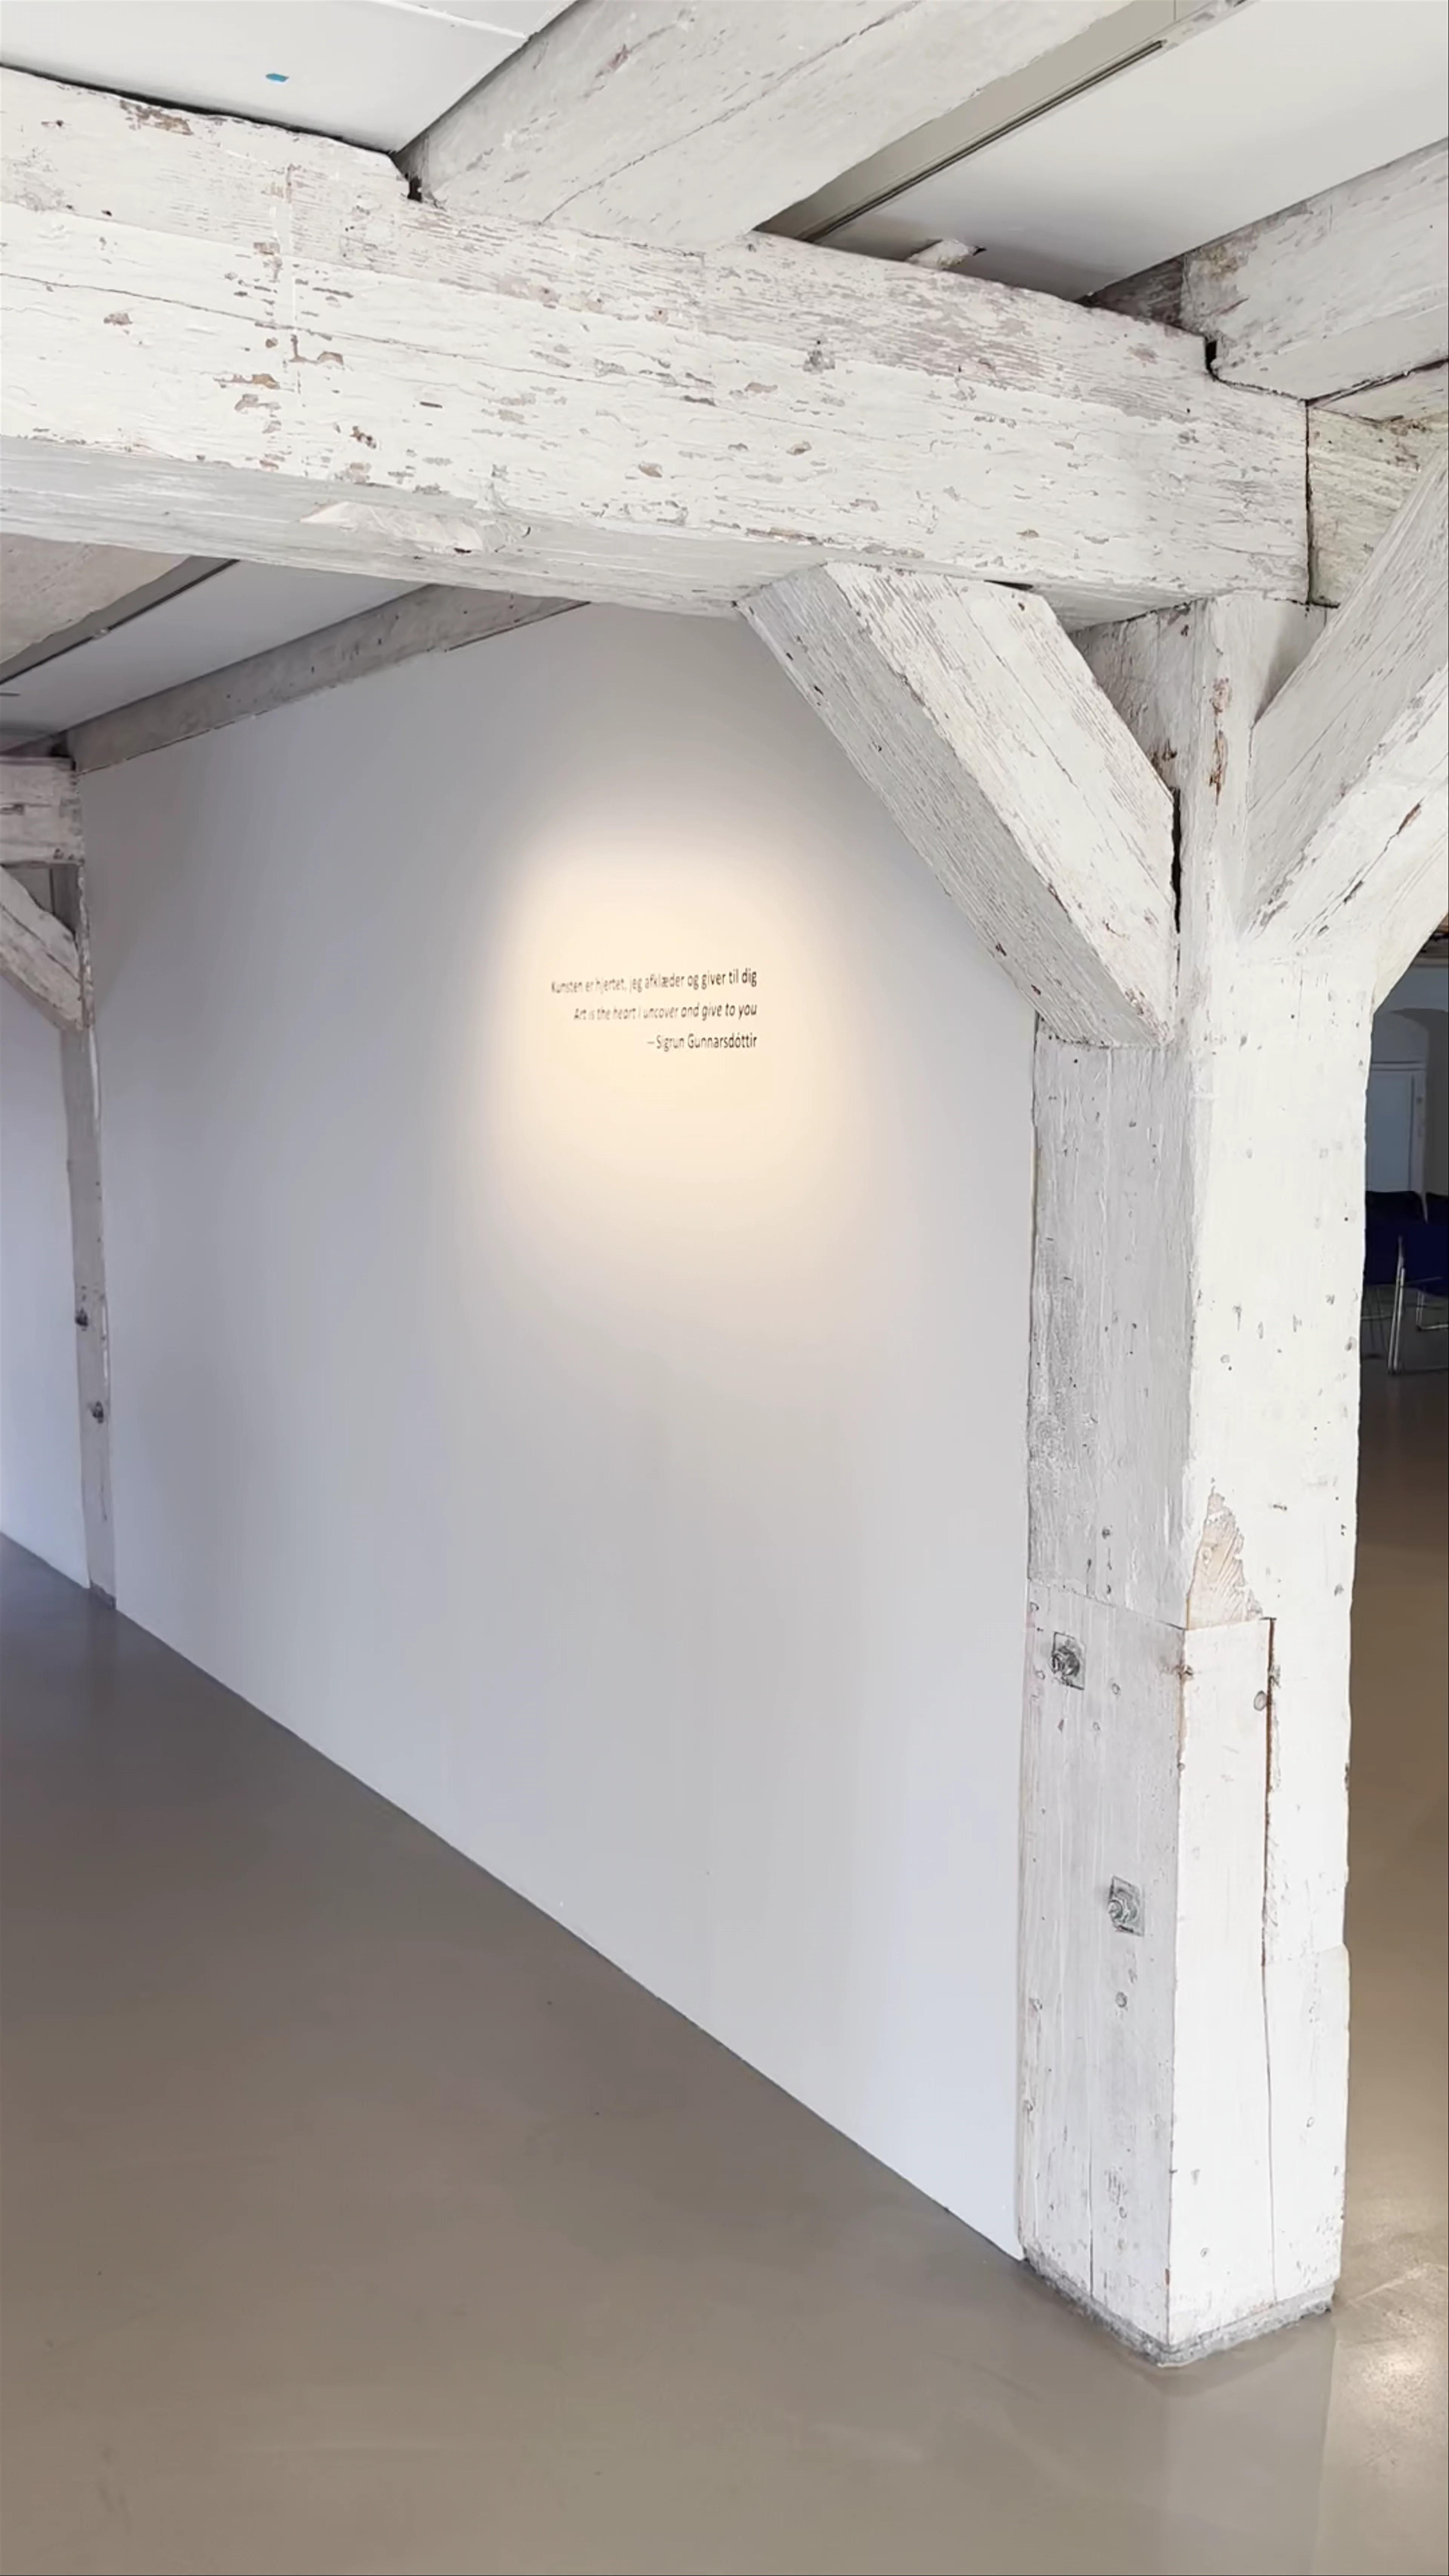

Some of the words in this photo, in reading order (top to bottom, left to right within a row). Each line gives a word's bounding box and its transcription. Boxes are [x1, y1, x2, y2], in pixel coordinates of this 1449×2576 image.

[551, 980, 583, 994] Kunsten
[585, 981, 594, 993] er
[629, 975, 643, 993] jeg
[645, 972, 685, 989] afklæder
[687, 974, 699, 990] og
[701, 970, 726, 990] giver
[729, 967, 739, 985] til
[741, 967, 757, 988] dig
[574, 1008, 587, 1020] Art
[597, 1005, 611, 1020] the
[612, 1005, 637, 1020] heart
[643, 1006, 679, 1019] uncover
[680, 1001, 700, 1018] and
[701, 1002, 722, 1021] give
[725, 1002, 736, 1017] to
[738, 1004, 758, 1021] you
[687, 1031, 758, 1049] Gunnarsdóttir
